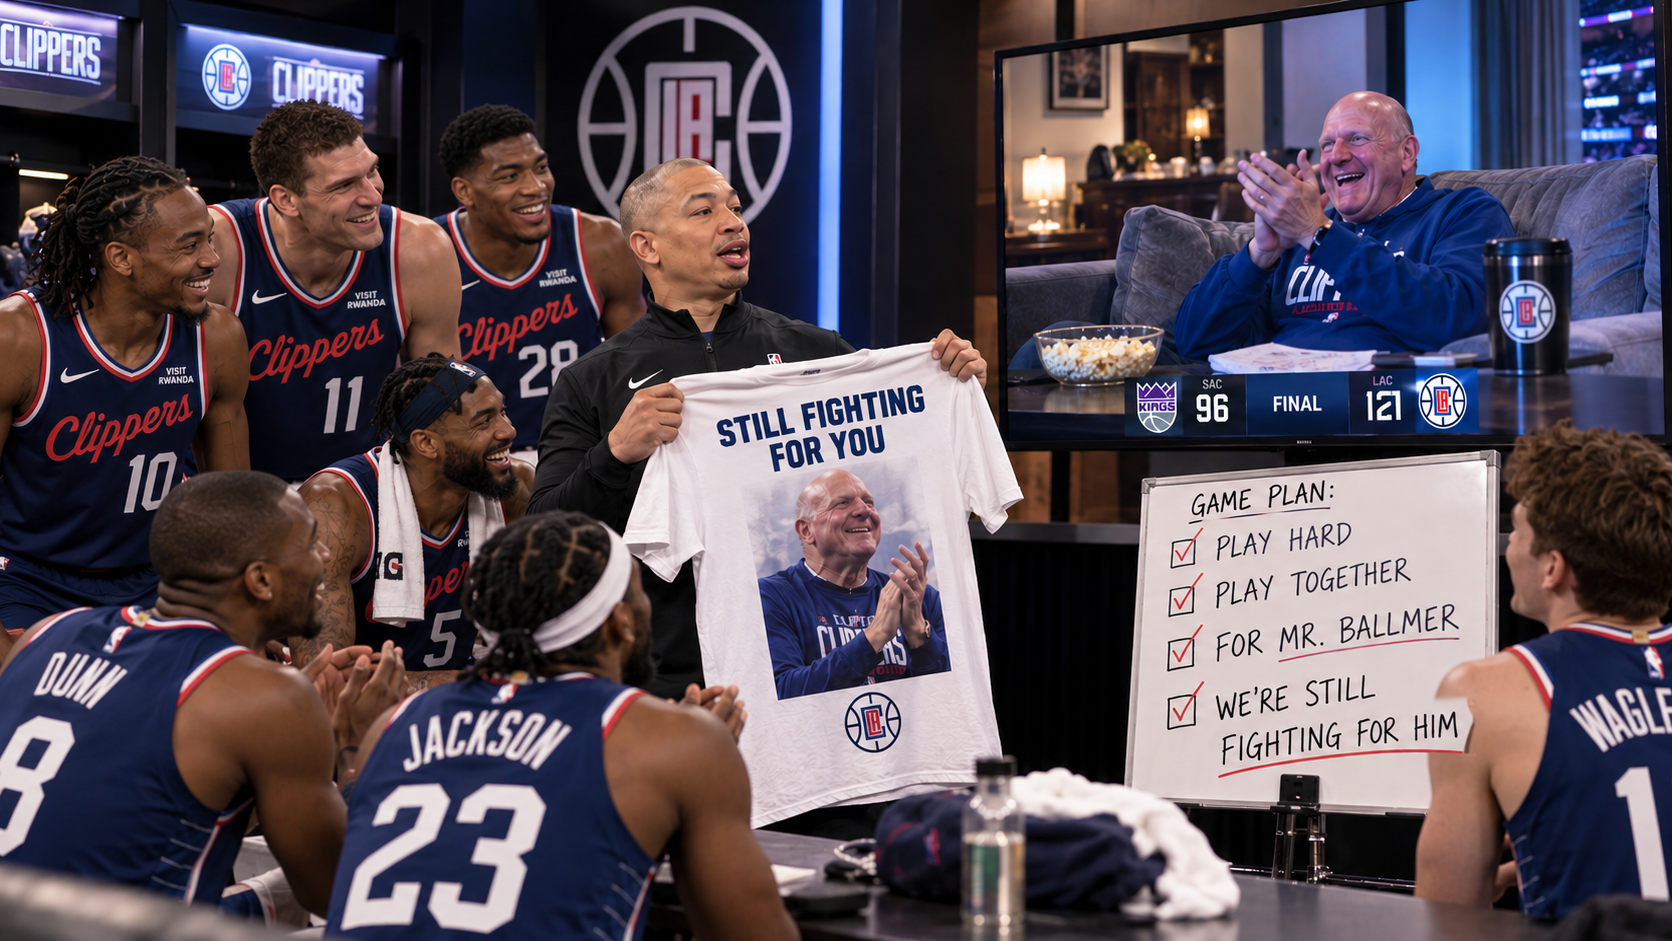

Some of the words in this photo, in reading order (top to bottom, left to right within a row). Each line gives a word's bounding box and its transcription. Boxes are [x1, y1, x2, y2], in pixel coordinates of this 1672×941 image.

[0, 23, 102, 80] CLIPPERS
[273, 60, 365, 114] CLIPPERS
[354, 290, 378, 300] VISIT
[539, 275, 577, 288] RWANDA
[545, 268, 568, 279] VISIT
[347, 298, 386, 309] RWANDA
[459, 293, 579, 361] Clippers
[166, 366, 187, 376] VISIT
[249, 318, 385, 384] Clippers
[518, 340, 579, 399] 28
[158, 374, 195, 385] RWANDA
[323, 376, 364, 434] 11
[1202, 379, 1223, 389] SAC
[1273, 395, 1323, 413] FINAL
[1373, 375, 1393, 386] LAC
[45, 393, 194, 463] Clippers
[716, 407, 797, 449] STILL
[800, 384, 926, 433] FIGHTING
[1196, 393, 1229, 423] 96
[769, 436, 825, 473] FOR
[828, 424, 886, 461] YOU
[123, 452, 178, 514] 10
[1191, 488, 1252, 517] GAME
[1268, 480, 1335, 509] PLAN:
[1216, 530, 1272, 561] PLAY
[1289, 522, 1352, 551] HARD
[1216, 575, 1274, 609] PLAY
[1290, 558, 1412, 596] TOGETHER
[422, 609, 462, 668] 5
[1216, 630, 1263, 662] FOR
[1279, 622, 1325, 652] MR.
[1339, 604, 1460, 644] BALLMER
[34, 652, 128, 710] DUNN
[1216, 686, 1289, 720] WE'RE
[1305, 675, 1376, 707] STILL
[403, 709, 573, 773] JACKSON
[1222, 722, 1342, 765] FIGHTING
[1357, 716, 1399, 747] FOR
[1414, 711, 1459, 741] HIM
[1569, 687, 1672, 753] WAGLE
[0, 715, 76, 857] 8
[339, 783, 547, 934] 23
[1615, 766, 1670, 902] 1
